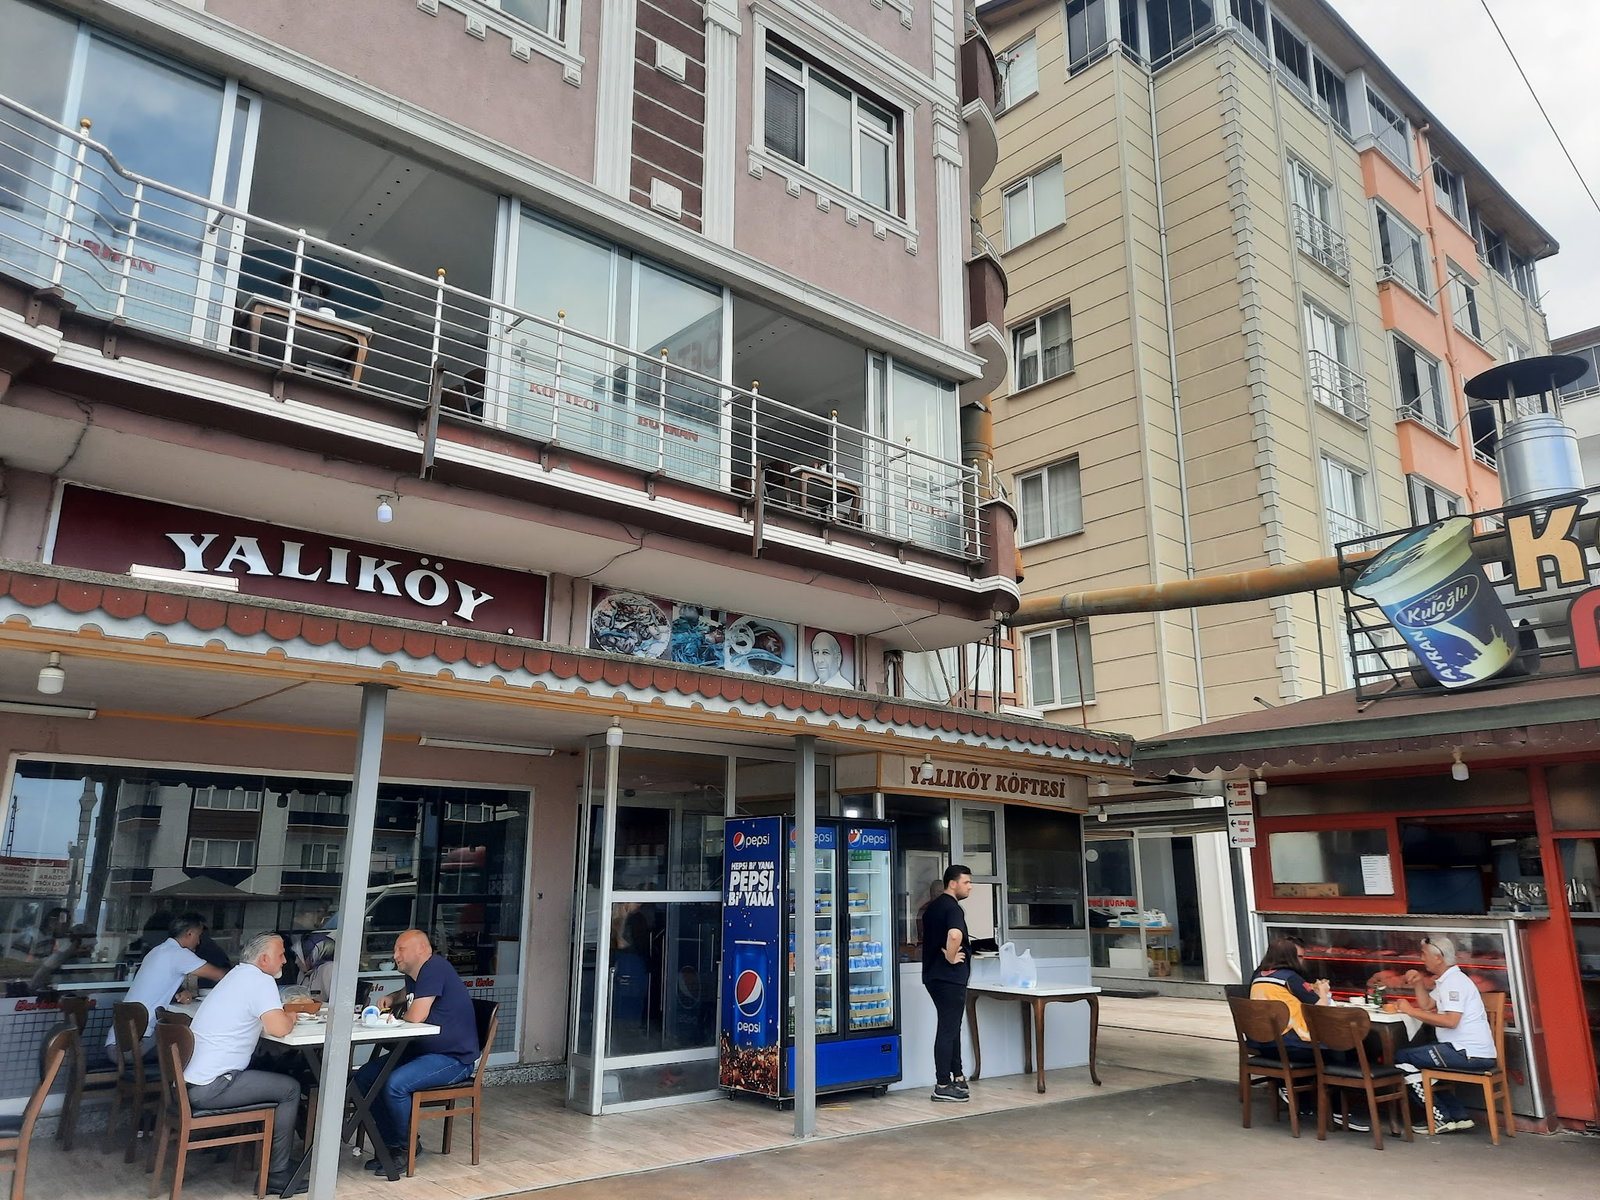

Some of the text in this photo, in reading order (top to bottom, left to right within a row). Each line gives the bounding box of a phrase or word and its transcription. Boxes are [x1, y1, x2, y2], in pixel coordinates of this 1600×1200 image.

[1508, 505, 1600, 591] K
[165, 532, 494, 622] YALIKÖY
[1408, 584, 1469, 624] Kuloğlu
[1410, 629, 1458, 680] AYRAN
[995, 772, 1066, 799] KÖFTESİ
[745, 833, 770, 849] pepsi
[814, 831, 833, 843] epsi
[862, 833, 887, 846] pepsi
[730, 870, 775, 892] PEPSI
[744, 891, 775, 907] YANA
[369, 983, 385, 992] sta
[737, 1021, 761, 1035] pepsi
